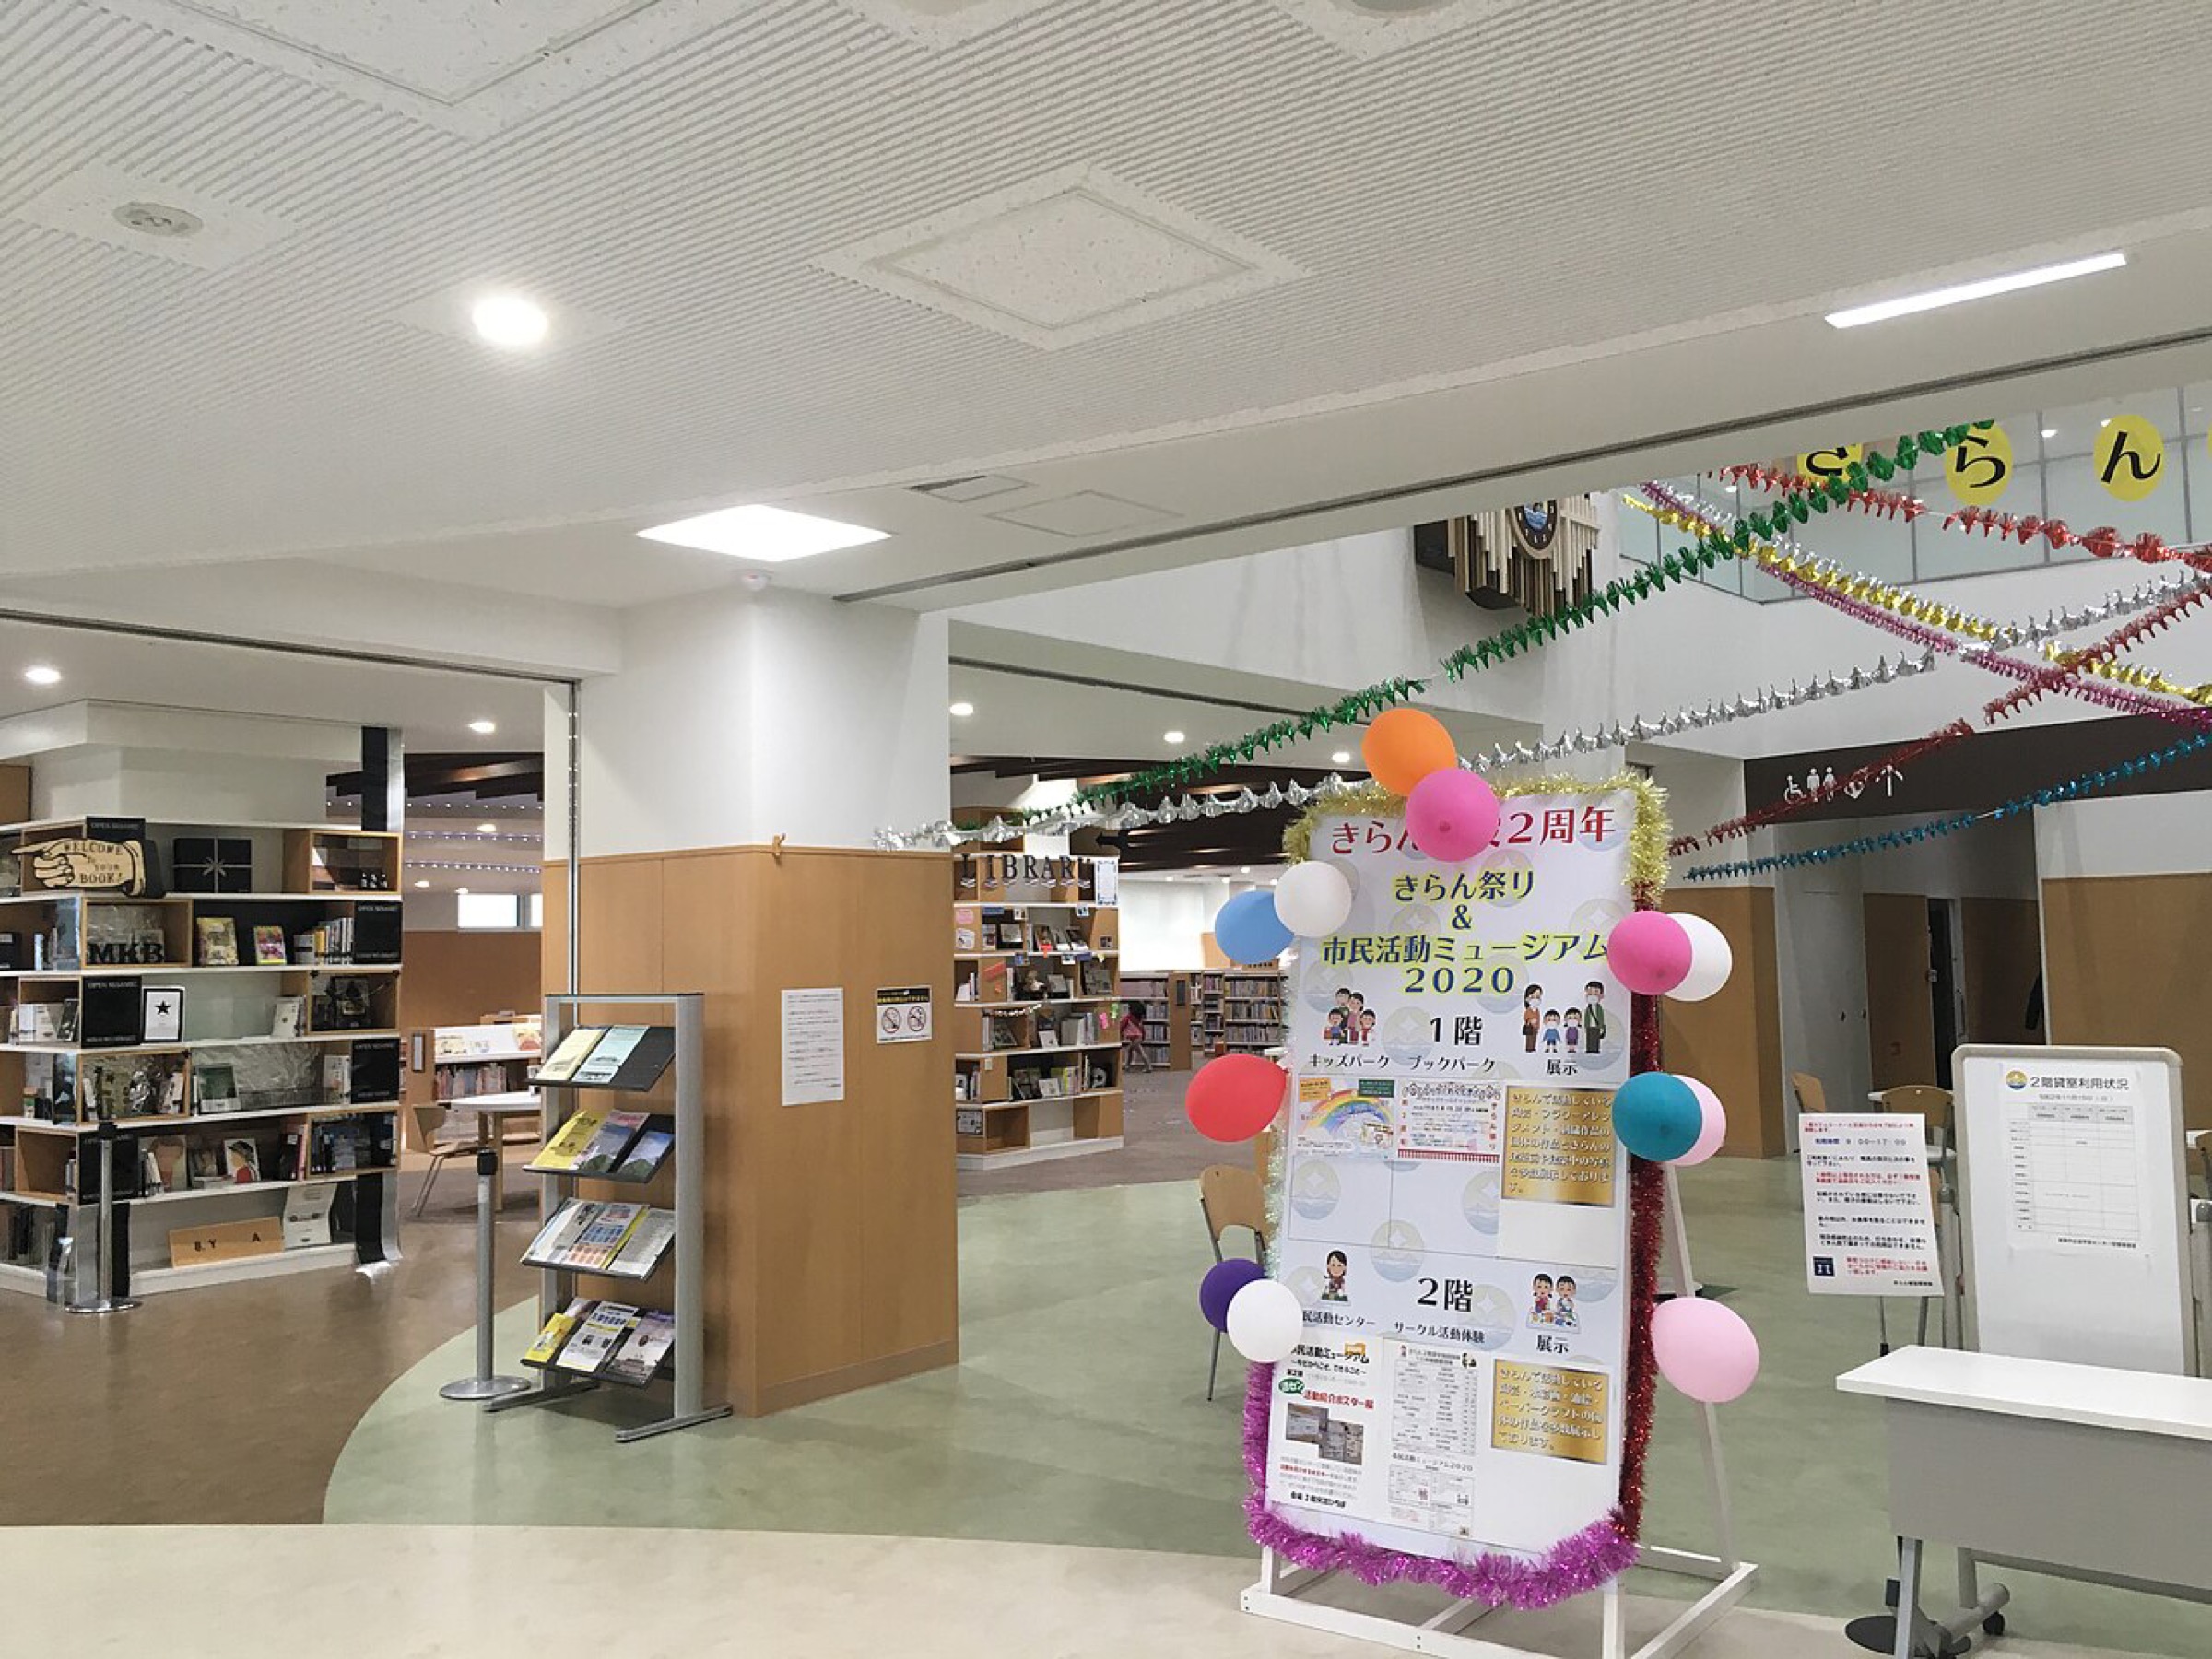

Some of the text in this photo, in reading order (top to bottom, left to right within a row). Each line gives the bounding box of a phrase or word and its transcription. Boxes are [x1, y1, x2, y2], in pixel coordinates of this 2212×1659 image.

[64, 840, 124, 855] WELCOME
[80, 872, 123, 884] BOOK!
[1394, 870, 1534, 901] きらん祭り
[1451, 904, 1473, 931] &
[1322, 933, 1608, 965] 市民活動ミュージアム
[1404, 967, 1515, 994] 2020
[1430, 1015, 1484, 1046] 1階
[1309, 1053, 1390, 1068] キッズパーク
[1408, 1055, 1497, 1073] ブックパーク
[1546, 1058, 1579, 1076] 展示
[1417, 1277, 1474, 1312] 2階
[1301, 1310, 1376, 1326] 民活動センター
[1394, 1321, 1486, 1345] サークル活動体験
[1535, 1334, 1569, 1354] 展示
